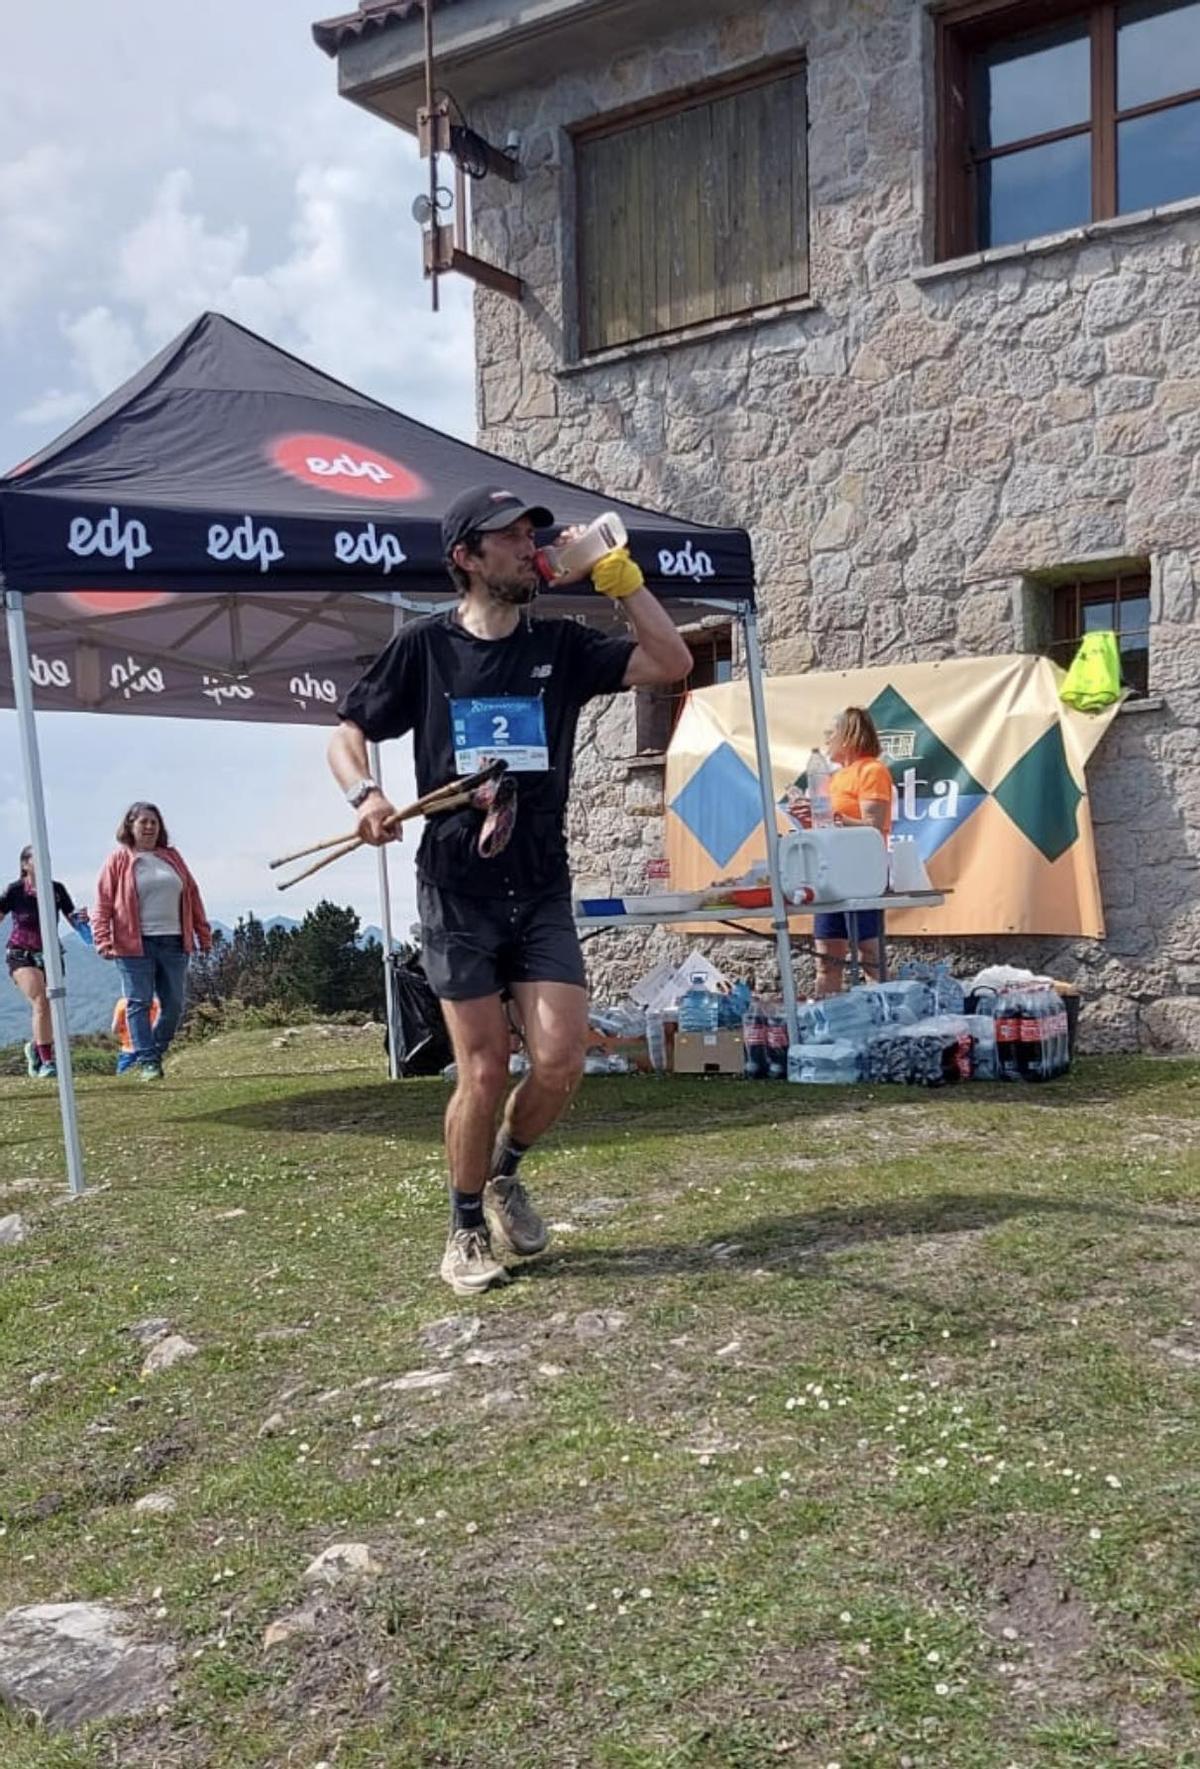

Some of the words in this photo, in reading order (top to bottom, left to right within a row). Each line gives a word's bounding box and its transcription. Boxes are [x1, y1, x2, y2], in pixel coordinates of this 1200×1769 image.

[68, 507, 152, 570] edp
[207, 516, 285, 573] edp
[334, 522, 407, 571] edp
[491, 715, 510, 739] 2
